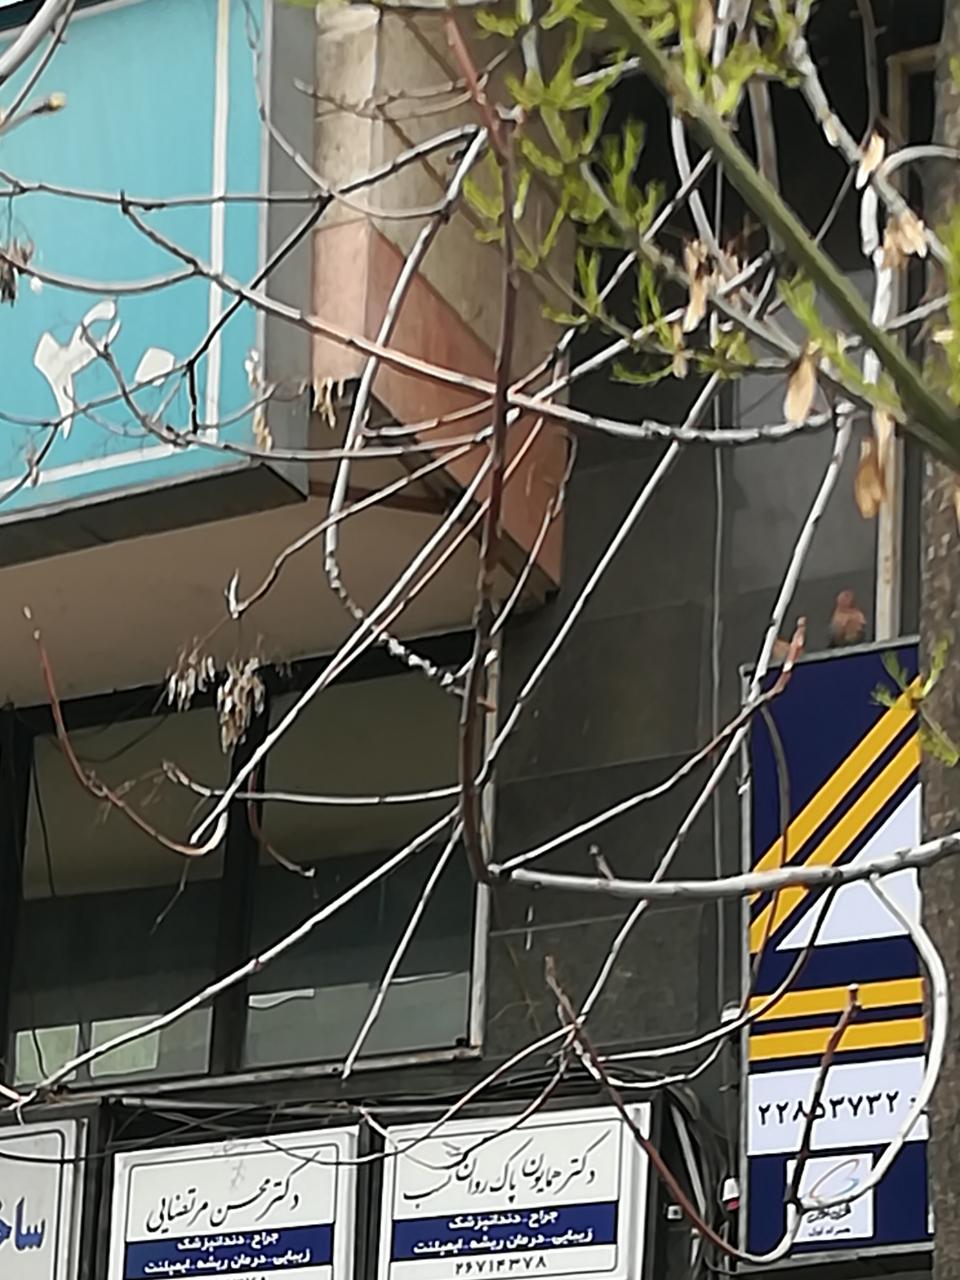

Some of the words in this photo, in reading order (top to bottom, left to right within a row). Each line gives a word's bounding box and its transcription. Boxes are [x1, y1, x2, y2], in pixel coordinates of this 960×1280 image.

[554, 1129, 611, 1196] دکتر
[254, 1150, 321, 1222] دکتر
[209, 1177, 272, 1227] محسن
[448, 1212, 521, 1232] دندانپزشک
[528, 1210, 559, 1229] جراح
[176, 1234, 245, 1252] دندانپزشک
[250, 1231, 280, 1249] جراح
[505, 1231, 544, 1249] درمان
[230, 1253, 267, 1269] درمان
